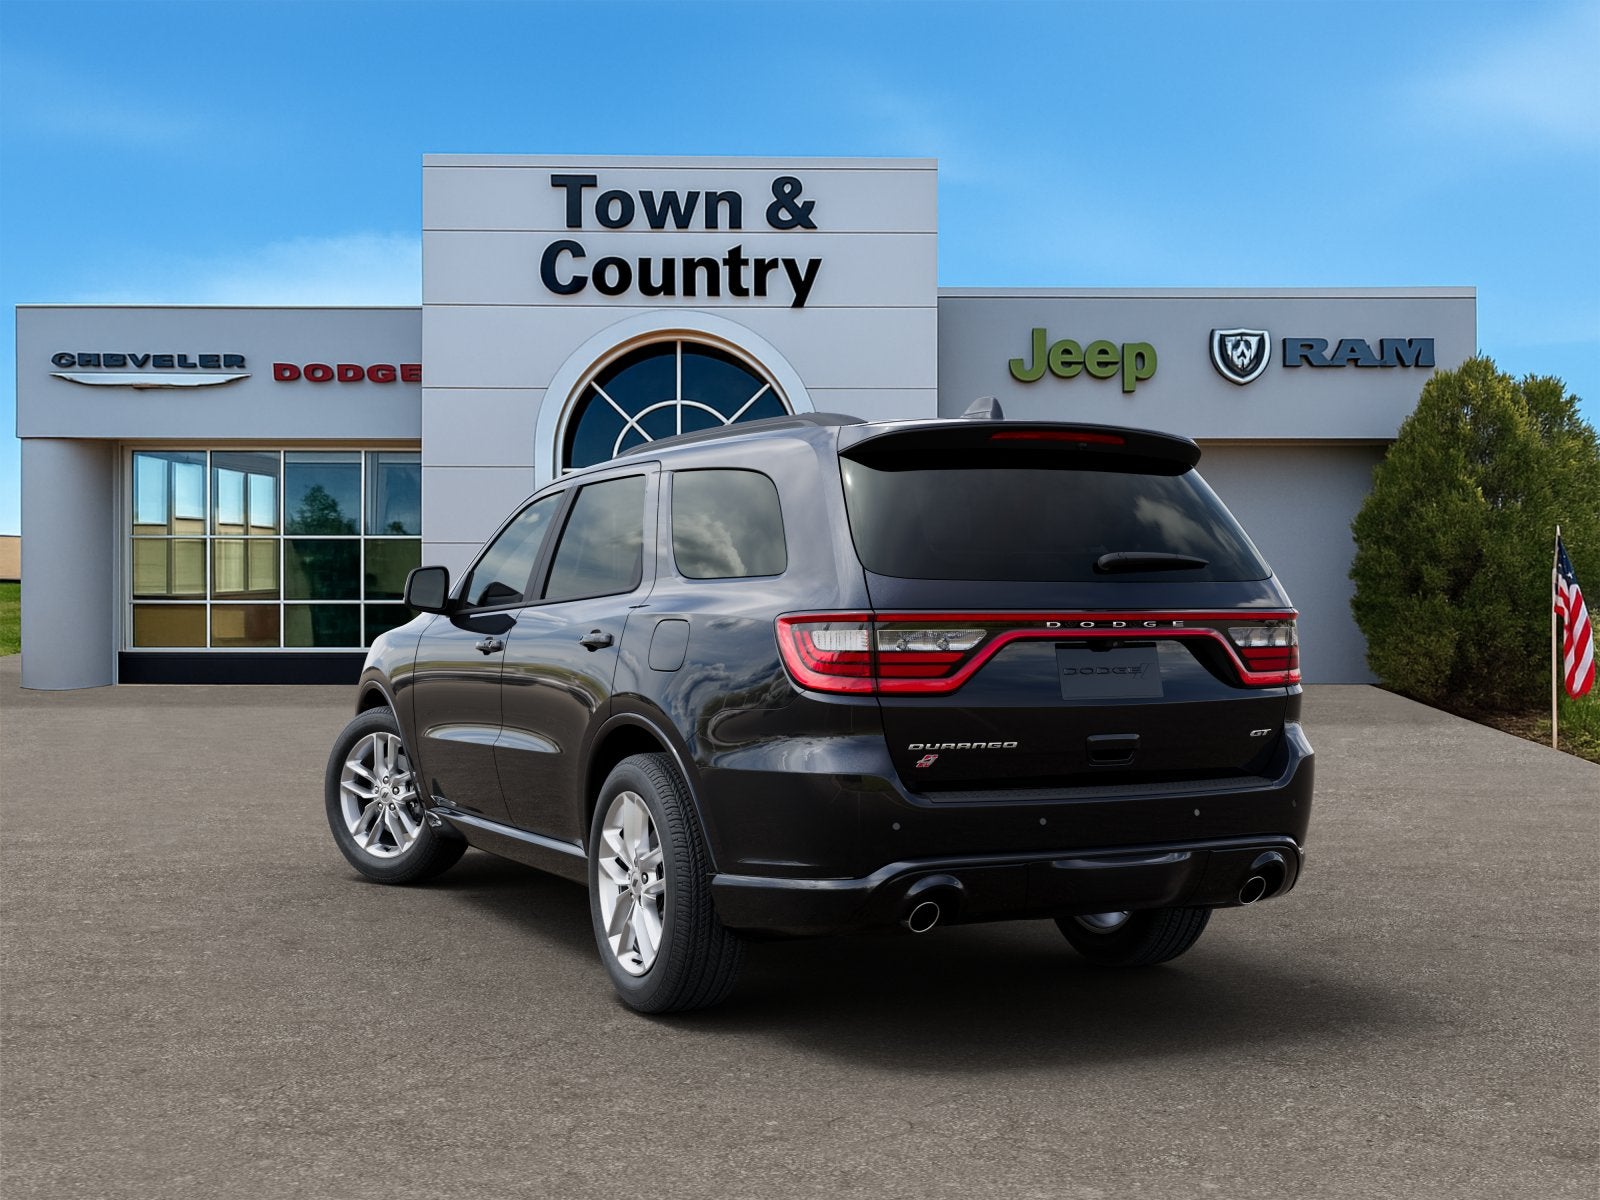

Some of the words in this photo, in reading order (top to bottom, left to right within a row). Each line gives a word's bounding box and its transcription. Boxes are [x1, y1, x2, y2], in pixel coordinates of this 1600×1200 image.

[550, 174, 742, 229] Town
[766, 176, 818, 230] &
[540, 239, 822, 308] Country
[1009, 328, 1157, 392] Jeep
[1282, 337, 1435, 368] RAM
[273, 363, 422, 383] DODGE
[1063, 667, 1141, 675] DODGE
[1249, 728, 1272, 737] GT
[907, 741, 1019, 751] DURANGO
